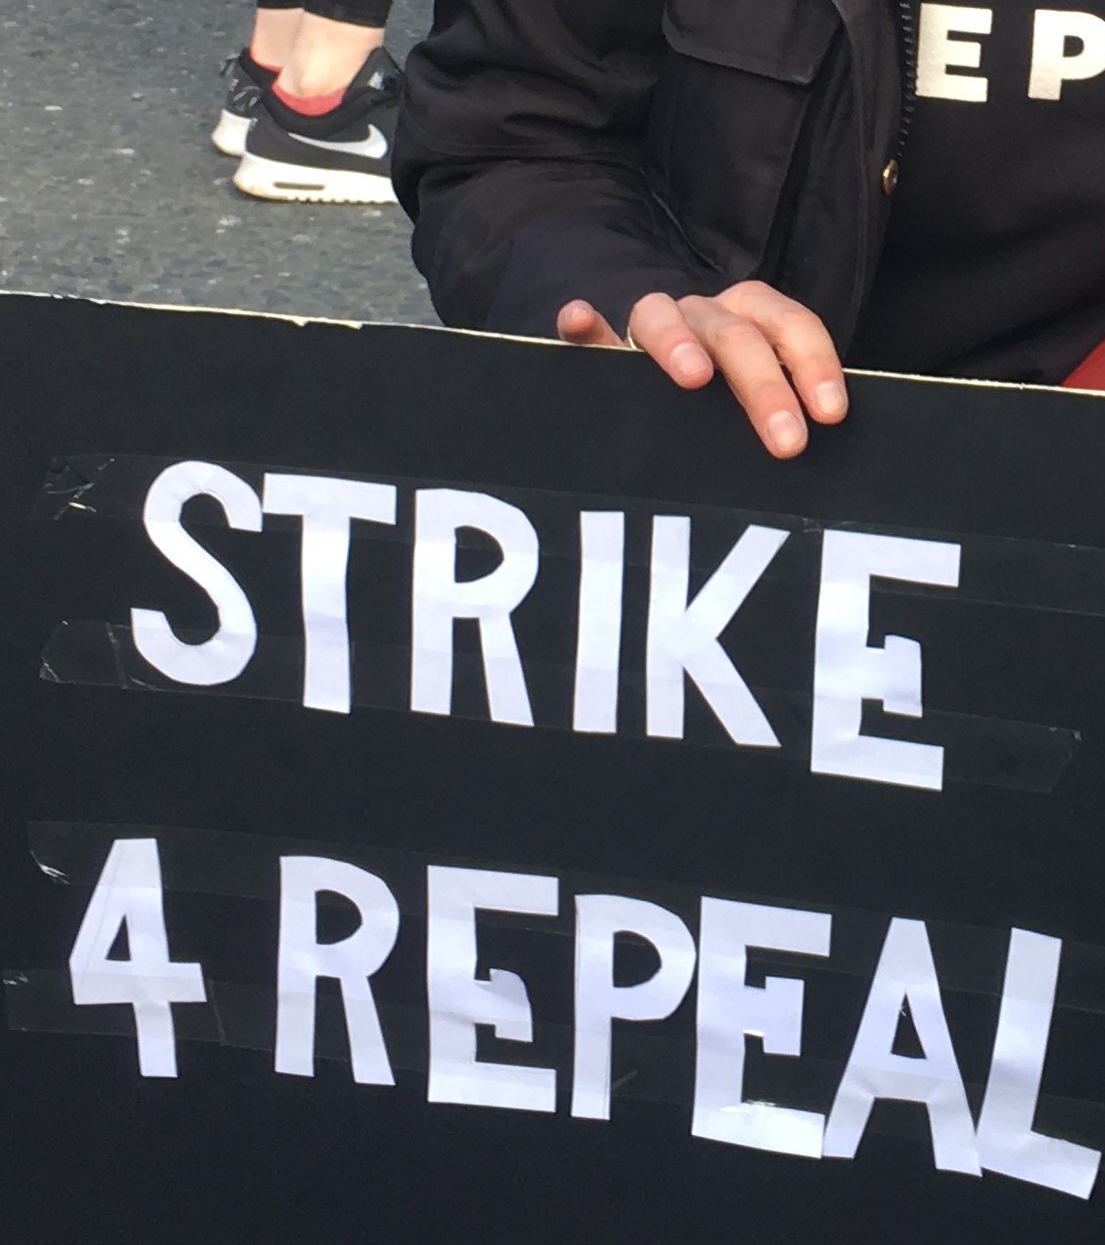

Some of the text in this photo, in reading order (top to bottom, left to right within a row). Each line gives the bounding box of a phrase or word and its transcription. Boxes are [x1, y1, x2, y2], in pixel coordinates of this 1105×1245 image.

[131, 461, 961, 790] STRIKE
[69, 838, 1102, 1200] 4 REPEAL
